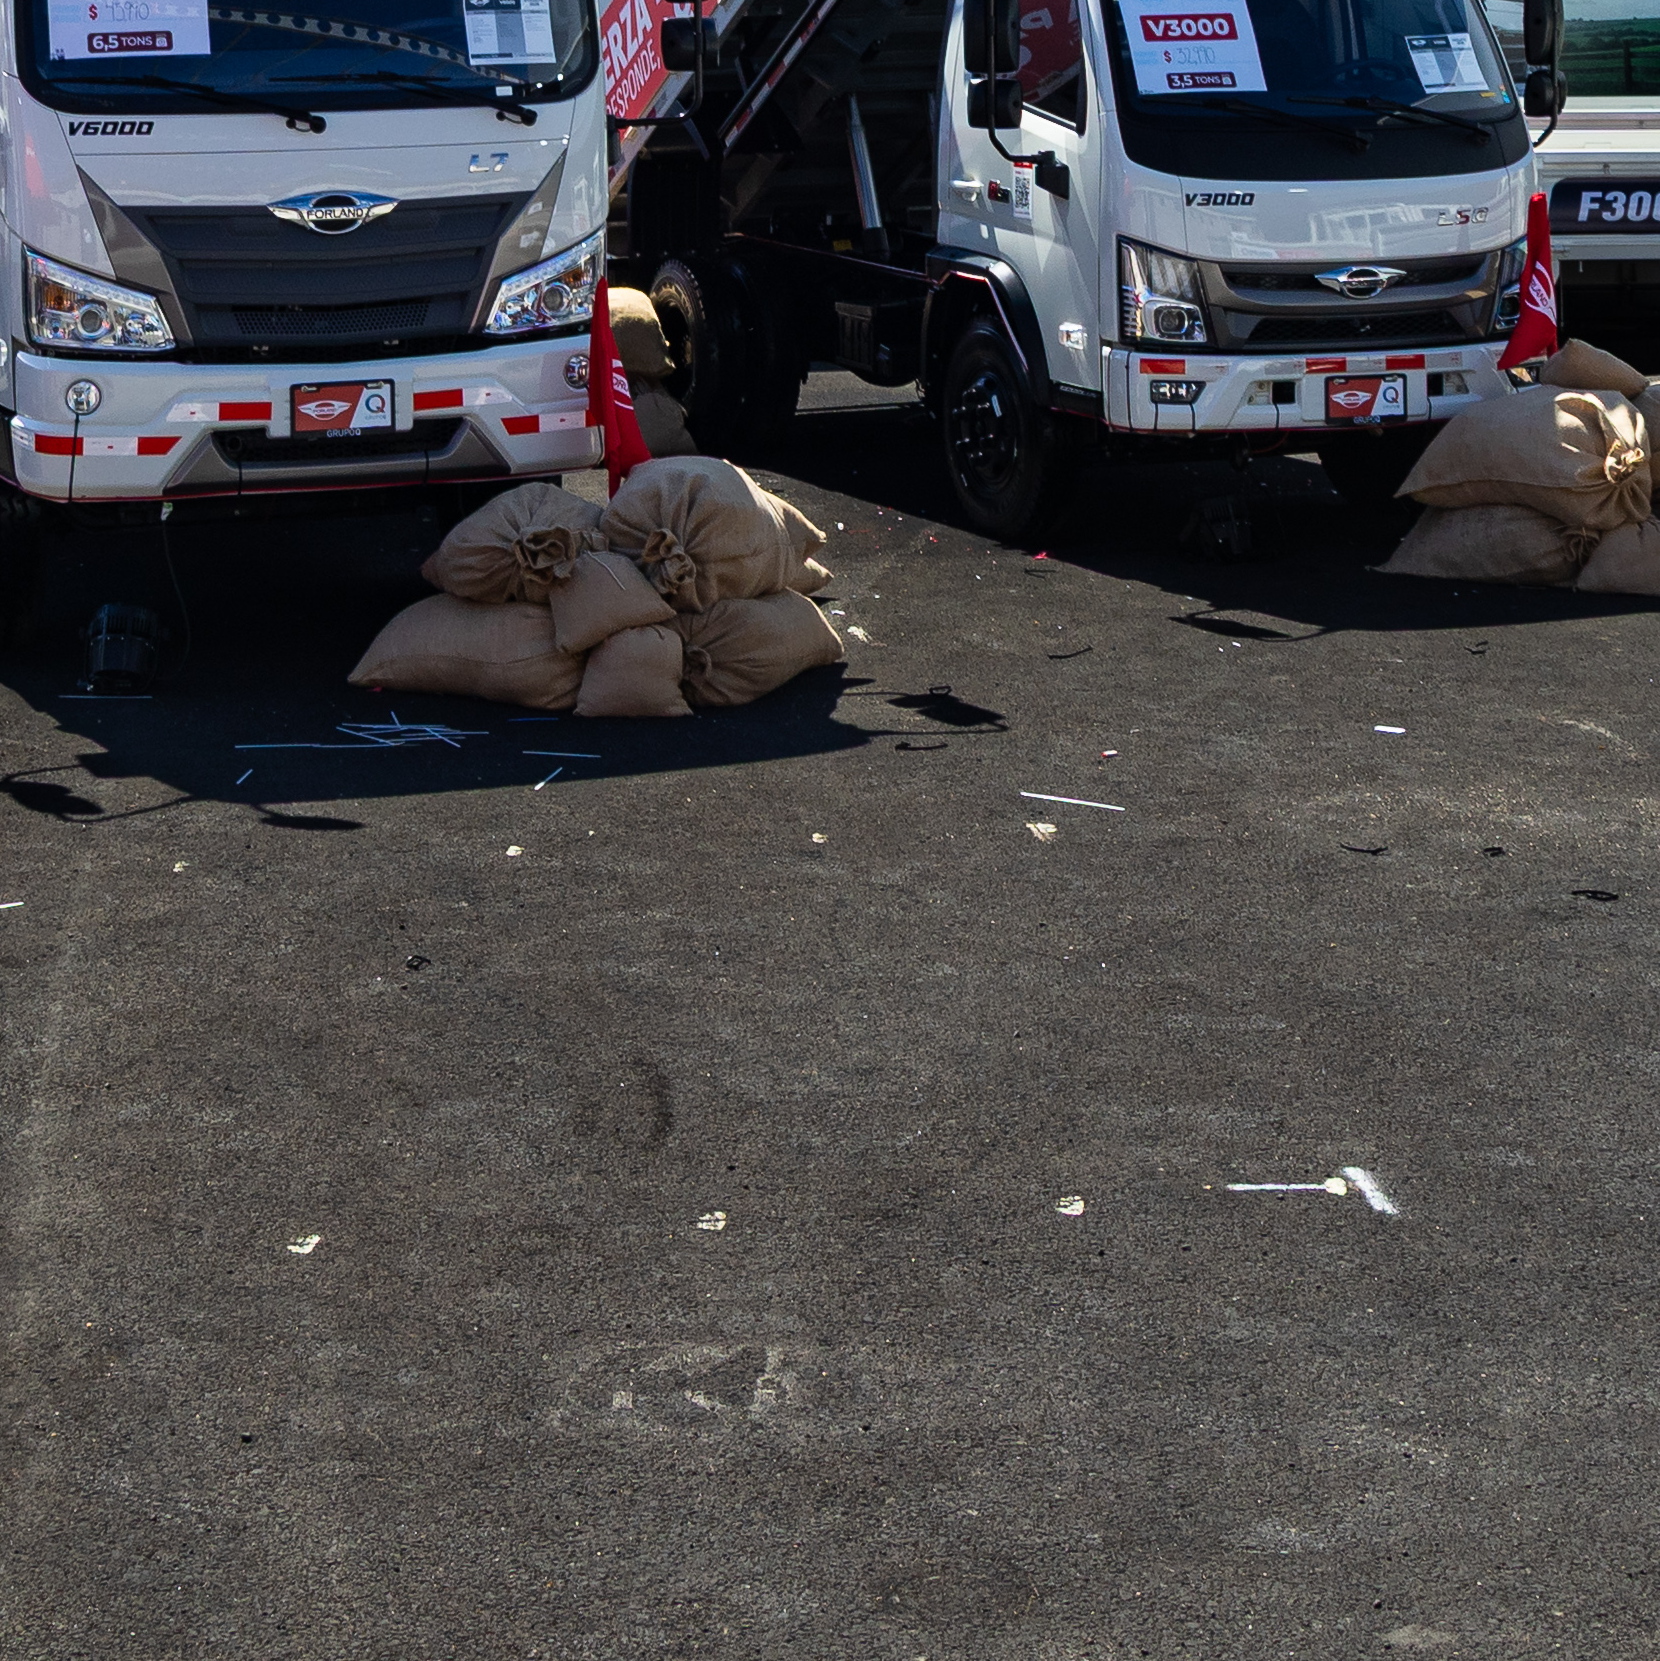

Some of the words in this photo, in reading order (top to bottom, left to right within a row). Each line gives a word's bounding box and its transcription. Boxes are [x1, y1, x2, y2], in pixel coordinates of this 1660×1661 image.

[89, 4, 98, 21] $
[1146, 18, 1229, 37] V3000
[92, 35, 119, 51] 6,5
[120, 35, 152, 47] TONS
[1163, 50, 1172, 63] $
[1170, 75, 1193, 88] 3,5
[1195, 76, 1221, 85] TONS
[68, 121, 154, 136] V6000
[468, 152, 509, 173] L7
[1185, 192, 1255, 206] V3000
[305, 207, 365, 219] FORLAND
[1382, 386, 1399, 404] Q
[365, 393, 386, 414] Q
